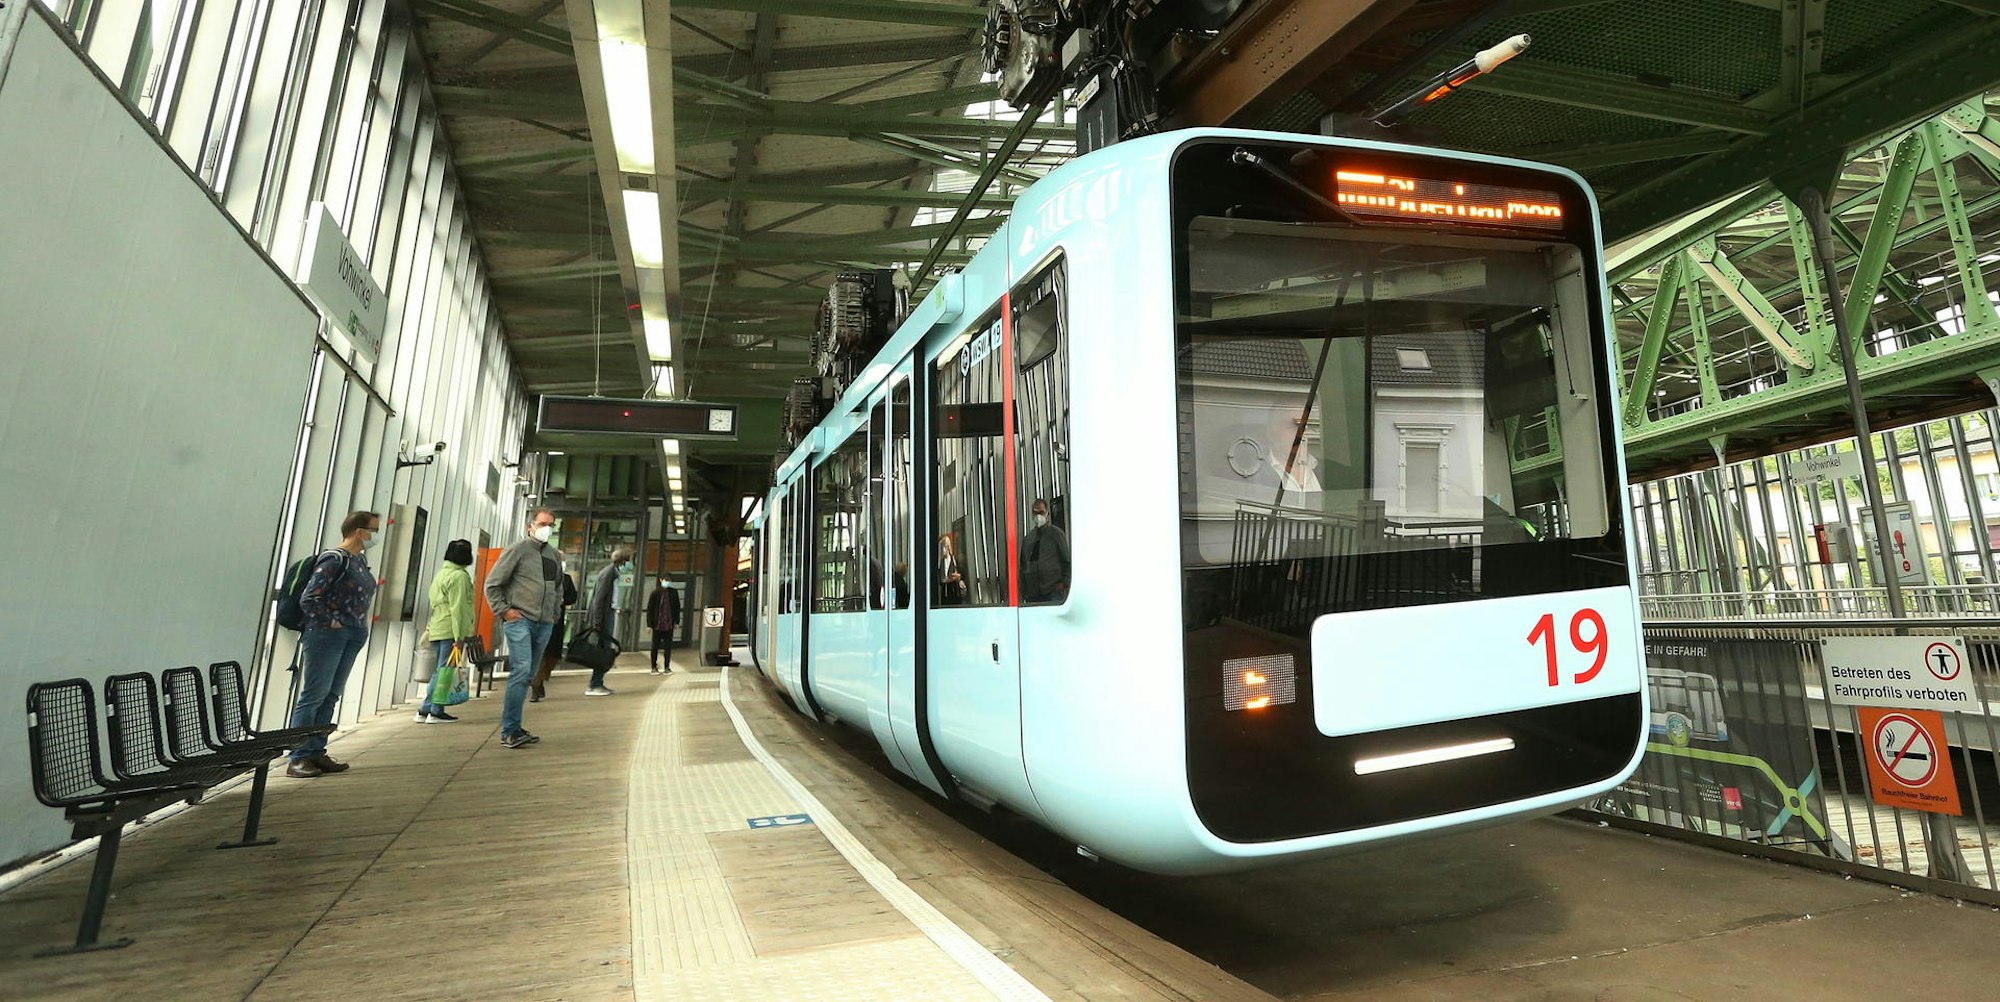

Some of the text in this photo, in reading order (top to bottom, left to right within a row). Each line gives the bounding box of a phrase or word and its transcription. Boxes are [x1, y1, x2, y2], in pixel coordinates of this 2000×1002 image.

[338, 242, 373, 313] Vohwinkel
[1806, 456, 1840, 471] Vohwinkel
[1526, 608, 1608, 687] 19
[1653, 645, 1663, 654] IN
[1665, 645, 1707, 657] GEFAHR!
[1831, 666, 1911, 680] Betreten des
[1834, 684, 1968, 702] Fahrprofils verboten
[1919, 792, 1948, 802] Bahnhof
